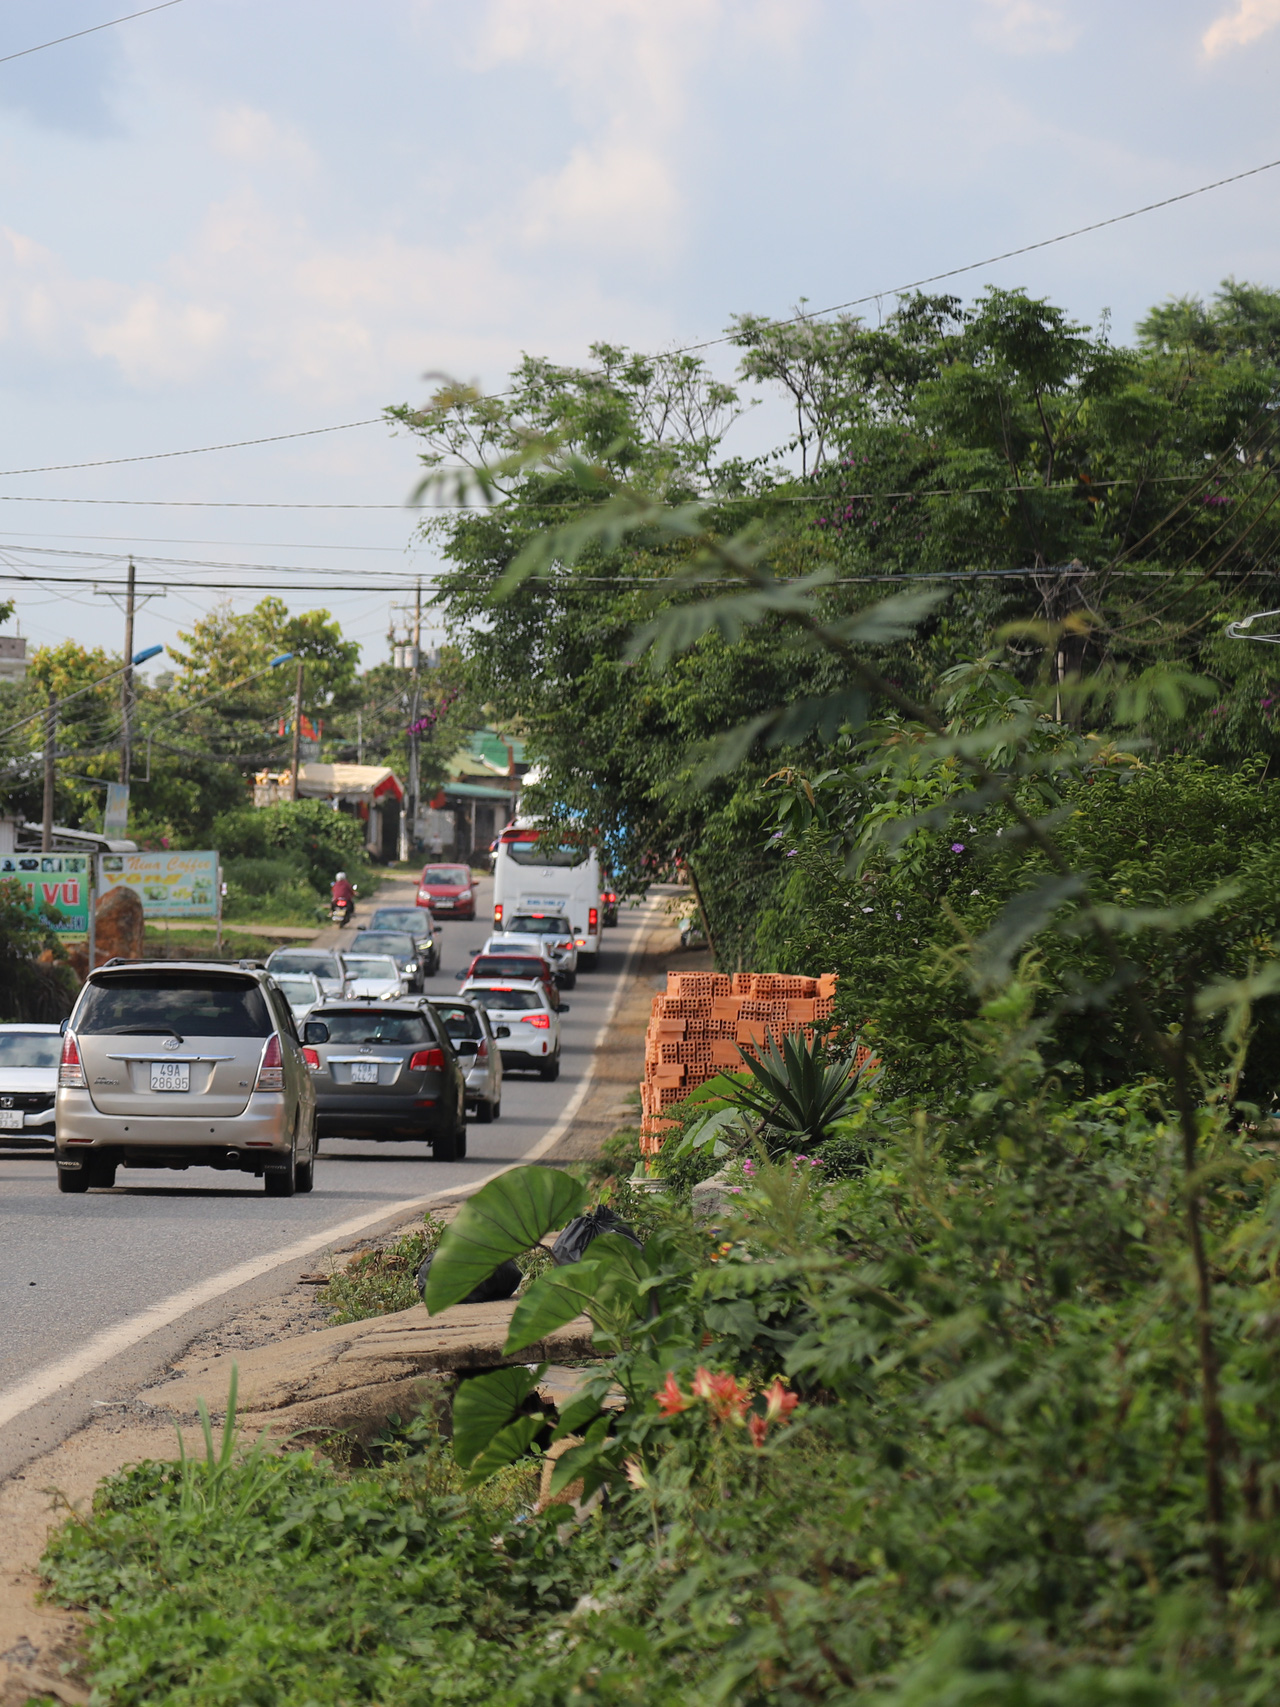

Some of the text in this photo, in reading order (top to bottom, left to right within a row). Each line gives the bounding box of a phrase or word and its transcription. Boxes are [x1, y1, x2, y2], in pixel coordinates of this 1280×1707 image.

[166, 856, 211, 872] Coffee
[41, 878, 80, 905] VŨ
[160, 1064, 180, 1076] 49A
[152, 1077, 188, 1089] 286.95
